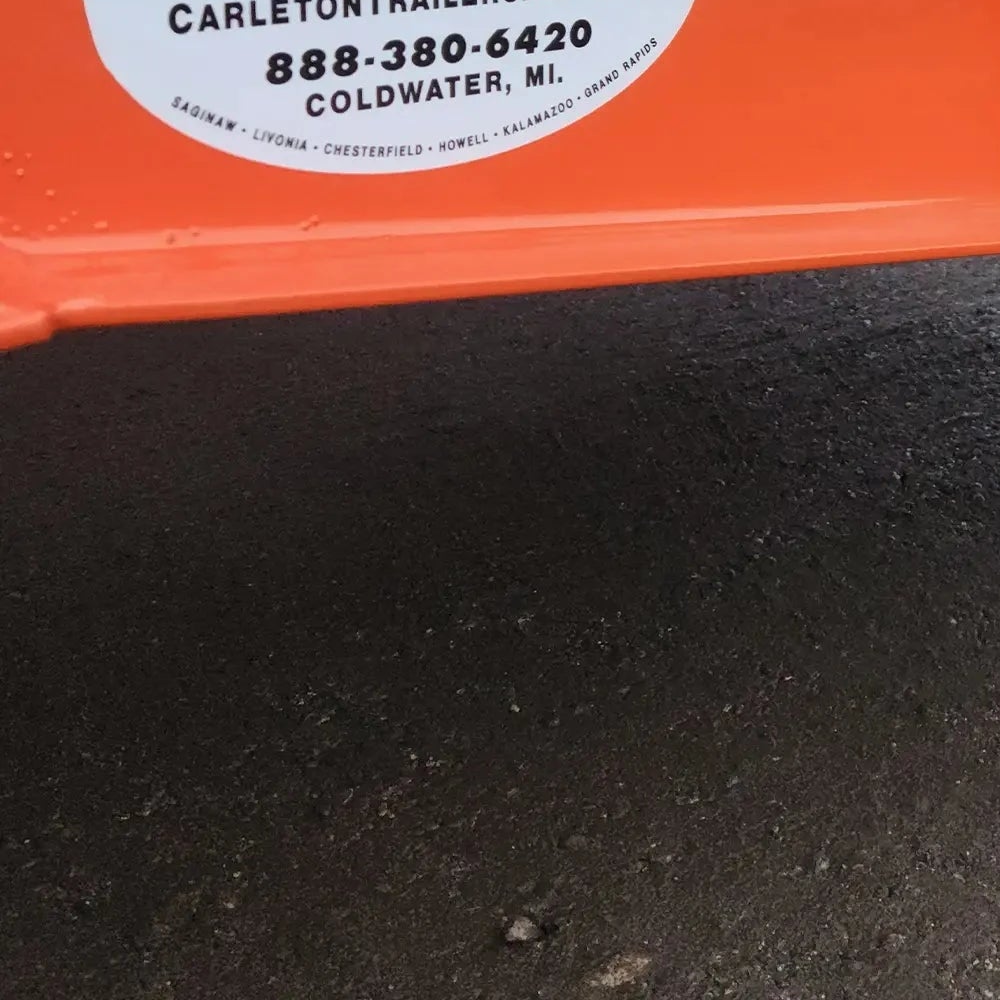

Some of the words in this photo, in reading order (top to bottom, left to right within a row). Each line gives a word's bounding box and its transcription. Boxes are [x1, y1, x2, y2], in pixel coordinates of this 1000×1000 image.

[266, 19, 593, 85] 888-380-6420
[170, 96, 238, 132] SAGINAW
[252, 128, 307, 152] LIVONIA
[323, 143, 423, 158] CHESTERFIELD
[438, 132, 489, 153] HOWELL
[502, 98, 574, 137] KALAMAZOO
[584, 69, 620, 98] GRAND
[621, 37, 658, 72] RAPIDS
[305, 70, 512, 117] COLDWATER,
[525, 63, 563, 88] MI.
